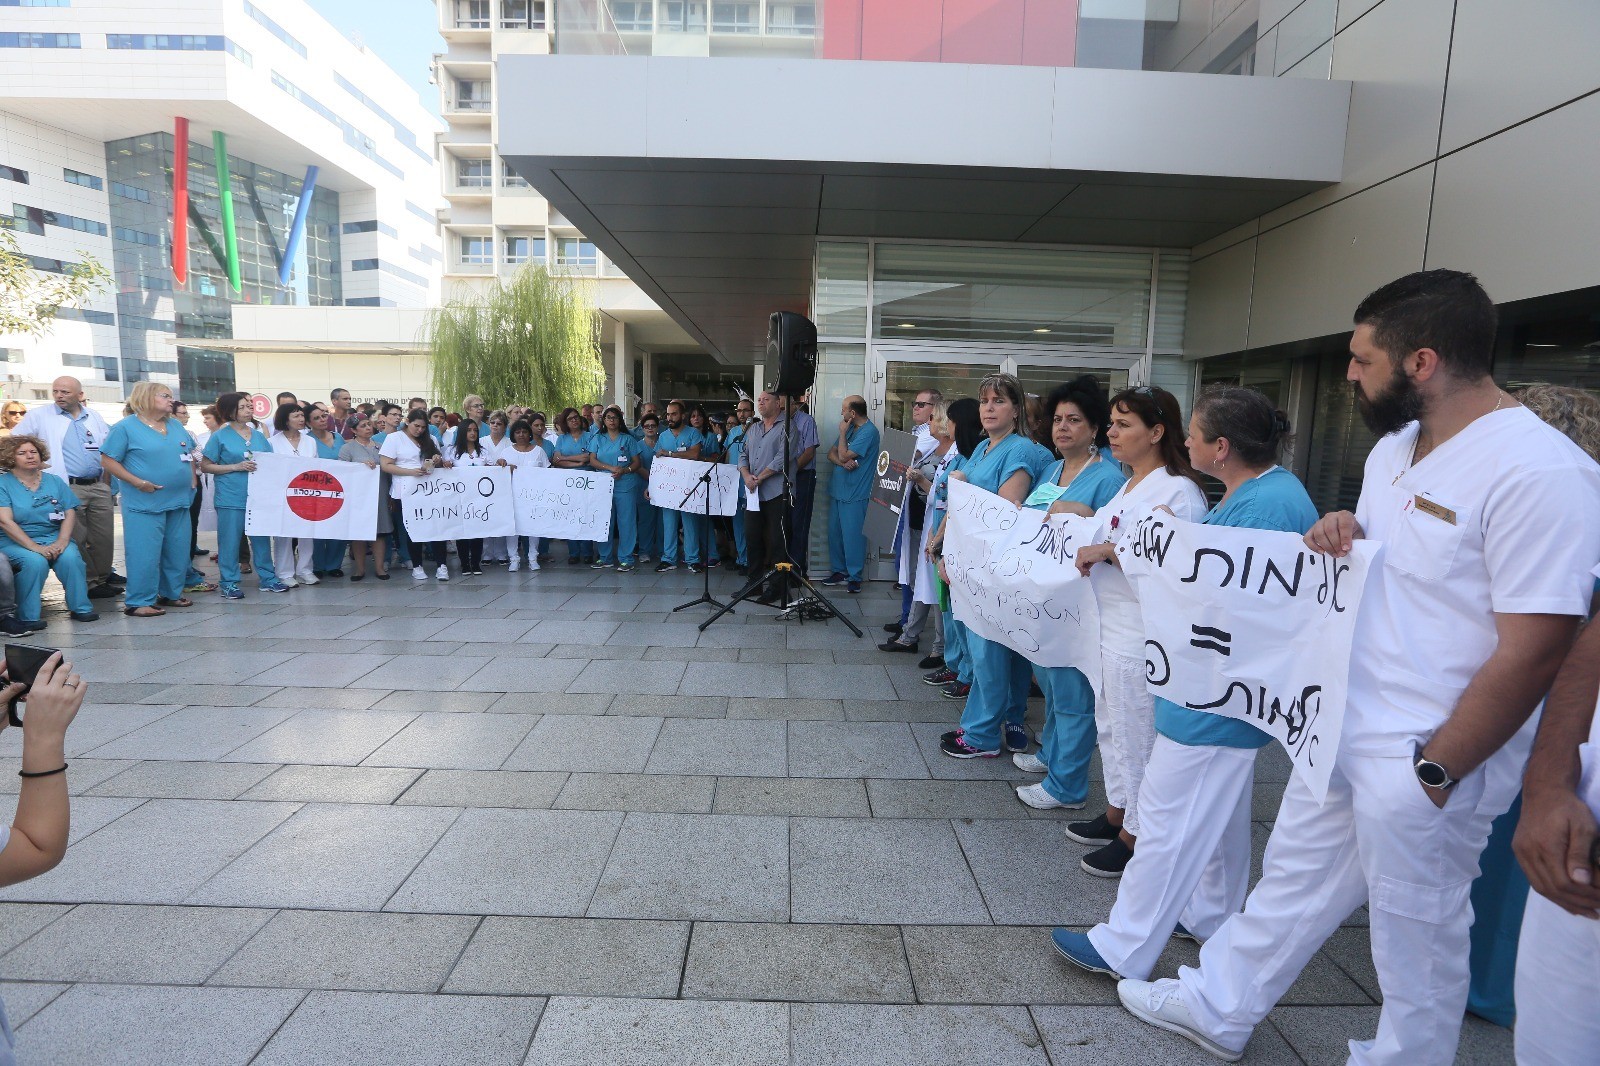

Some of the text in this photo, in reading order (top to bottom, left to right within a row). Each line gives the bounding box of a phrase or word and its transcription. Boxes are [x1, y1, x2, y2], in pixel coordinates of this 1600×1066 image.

[411, 478, 466, 496] סובלנות
[565, 476, 595, 491] אפס
[1180, 545, 1350, 619] אלימות
